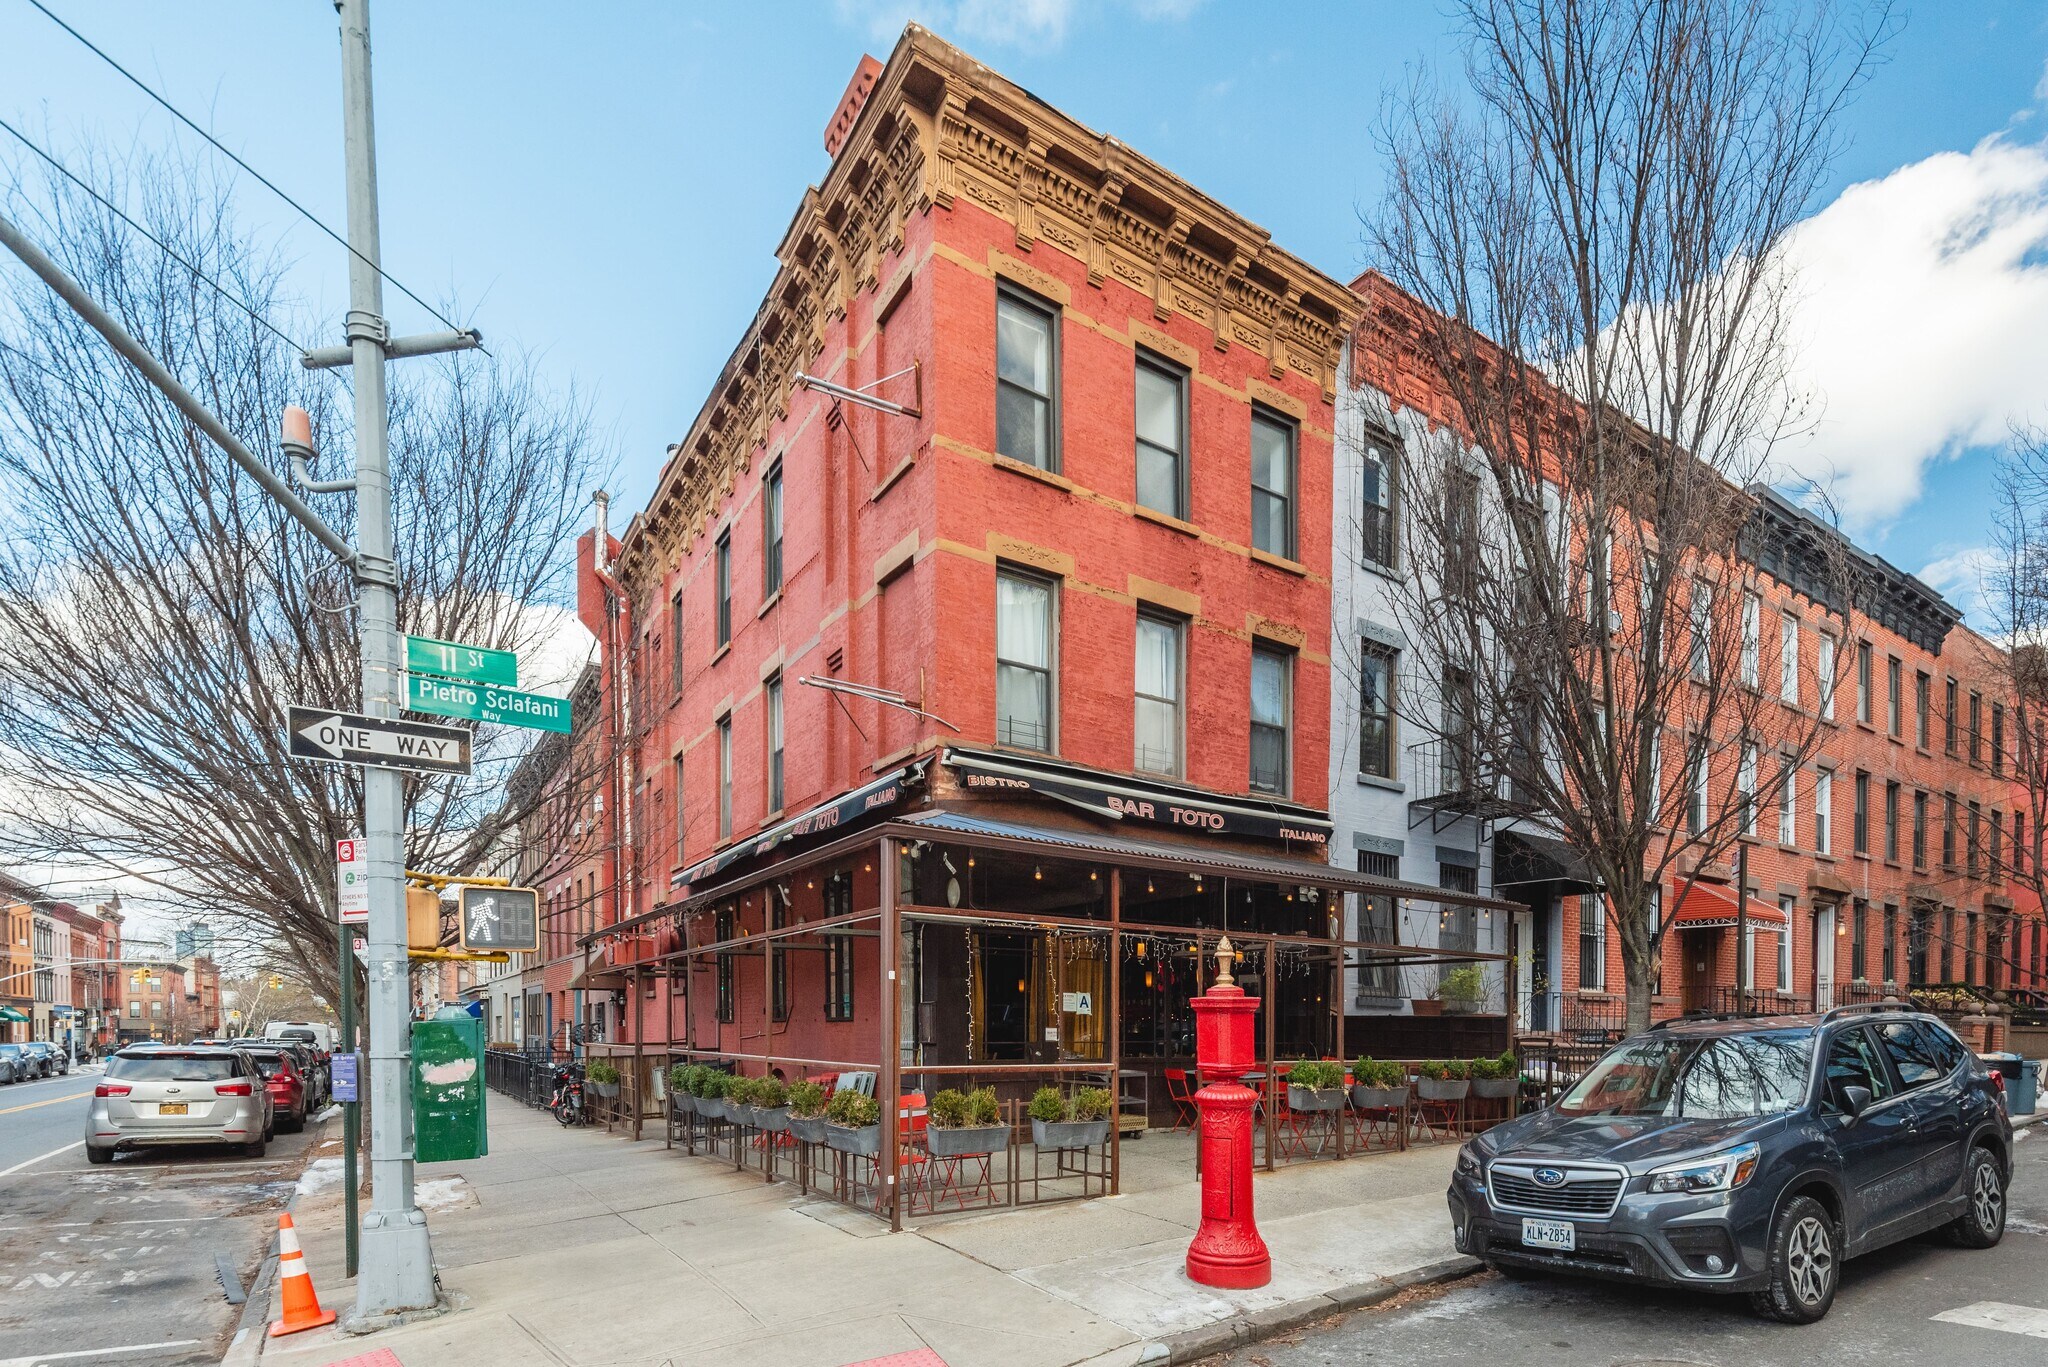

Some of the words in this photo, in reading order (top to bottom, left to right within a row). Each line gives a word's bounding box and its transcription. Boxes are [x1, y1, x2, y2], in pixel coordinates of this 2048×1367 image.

[439, 646, 457, 673] 11
[468, 651, 484, 668] St
[419, 680, 477, 705] Pietro
[486, 690, 559, 718] Sclafani
[481, 709, 502, 723] Way
[319, 726, 371, 750] ONE
[396, 736, 449, 759] WAY
[967, 774, 1030, 789] BISTRO
[865, 787, 896, 810] ITALIANO
[814, 807, 839, 831] TOTO
[1107, 796, 1155, 819] BAR
[1169, 807, 1225, 829] TOTO
[1280, 828, 1326, 843] ITALIANO
[1079, 995, 1089, 1008] A
